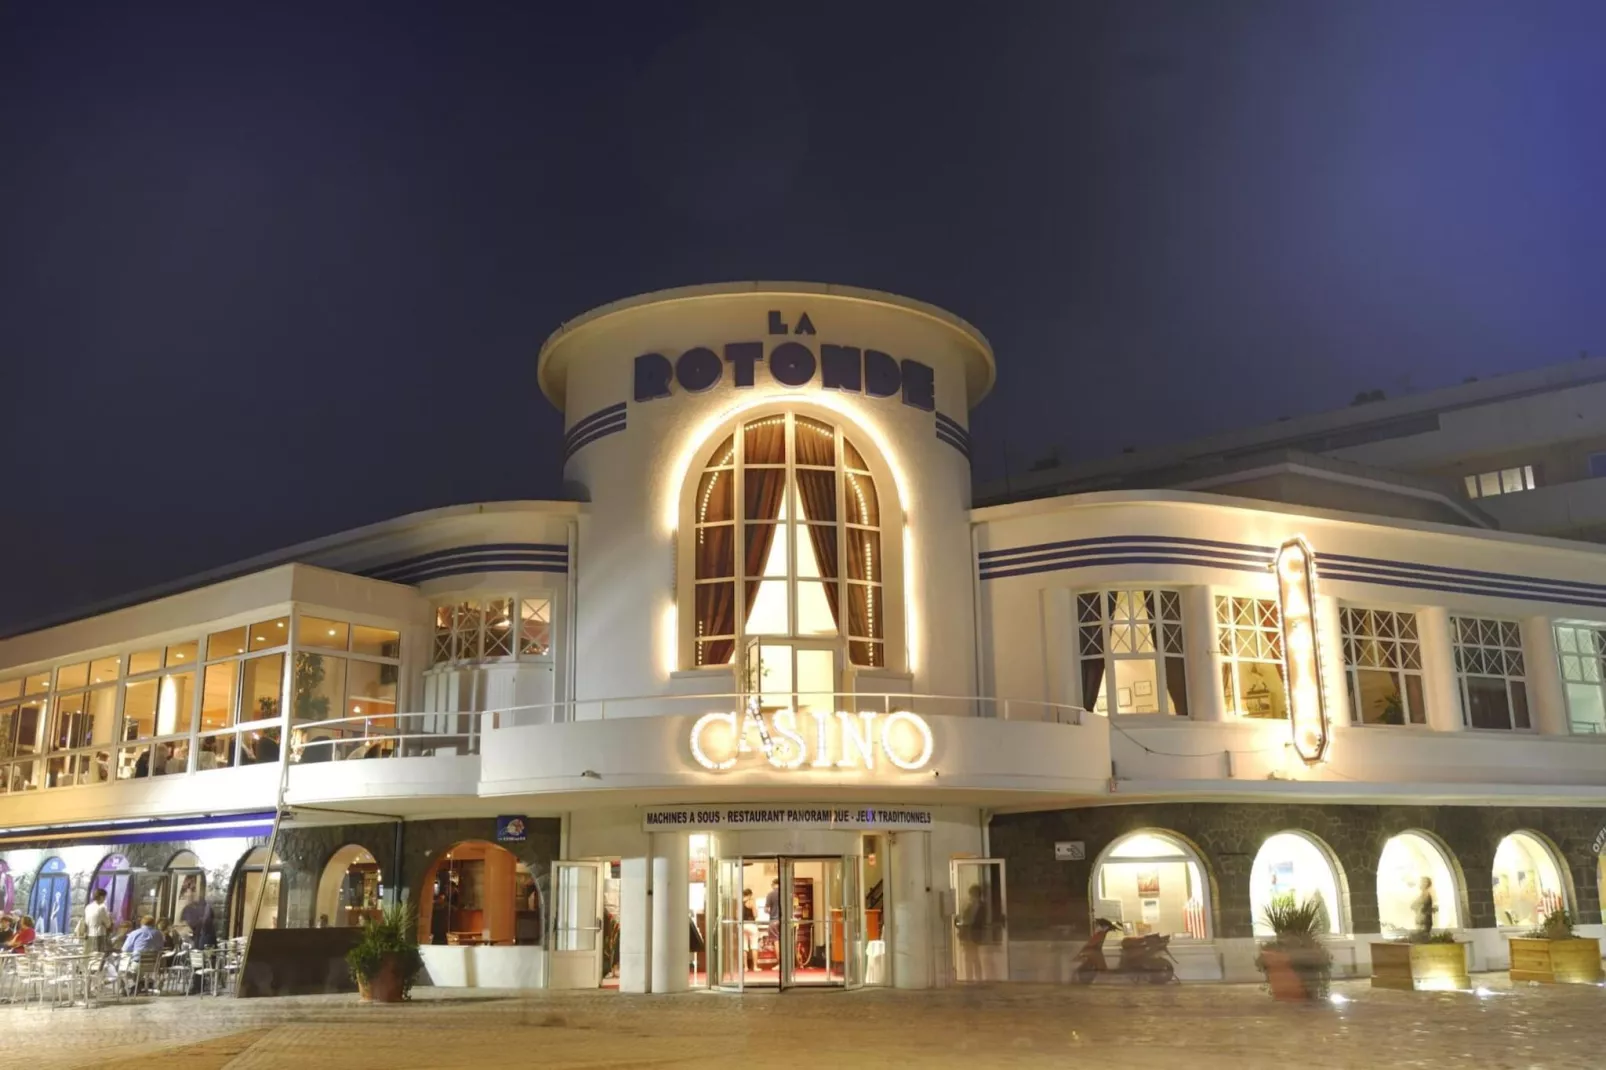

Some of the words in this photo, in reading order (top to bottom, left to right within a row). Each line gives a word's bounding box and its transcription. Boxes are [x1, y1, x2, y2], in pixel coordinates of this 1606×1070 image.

[768, 310, 816, 335] LA
[634, 341, 935, 411] ROTONDE
[690, 710, 934, 770] CASINO
[647, 812, 687, 824] MACHINES
[690, 811, 695, 823] A
[697, 811, 719, 823] SOUS
[728, 810, 785, 822] RESTAURANT
[856, 810, 876, 822] JEUX
[878, 810, 931, 823] TRADITIONNELS
